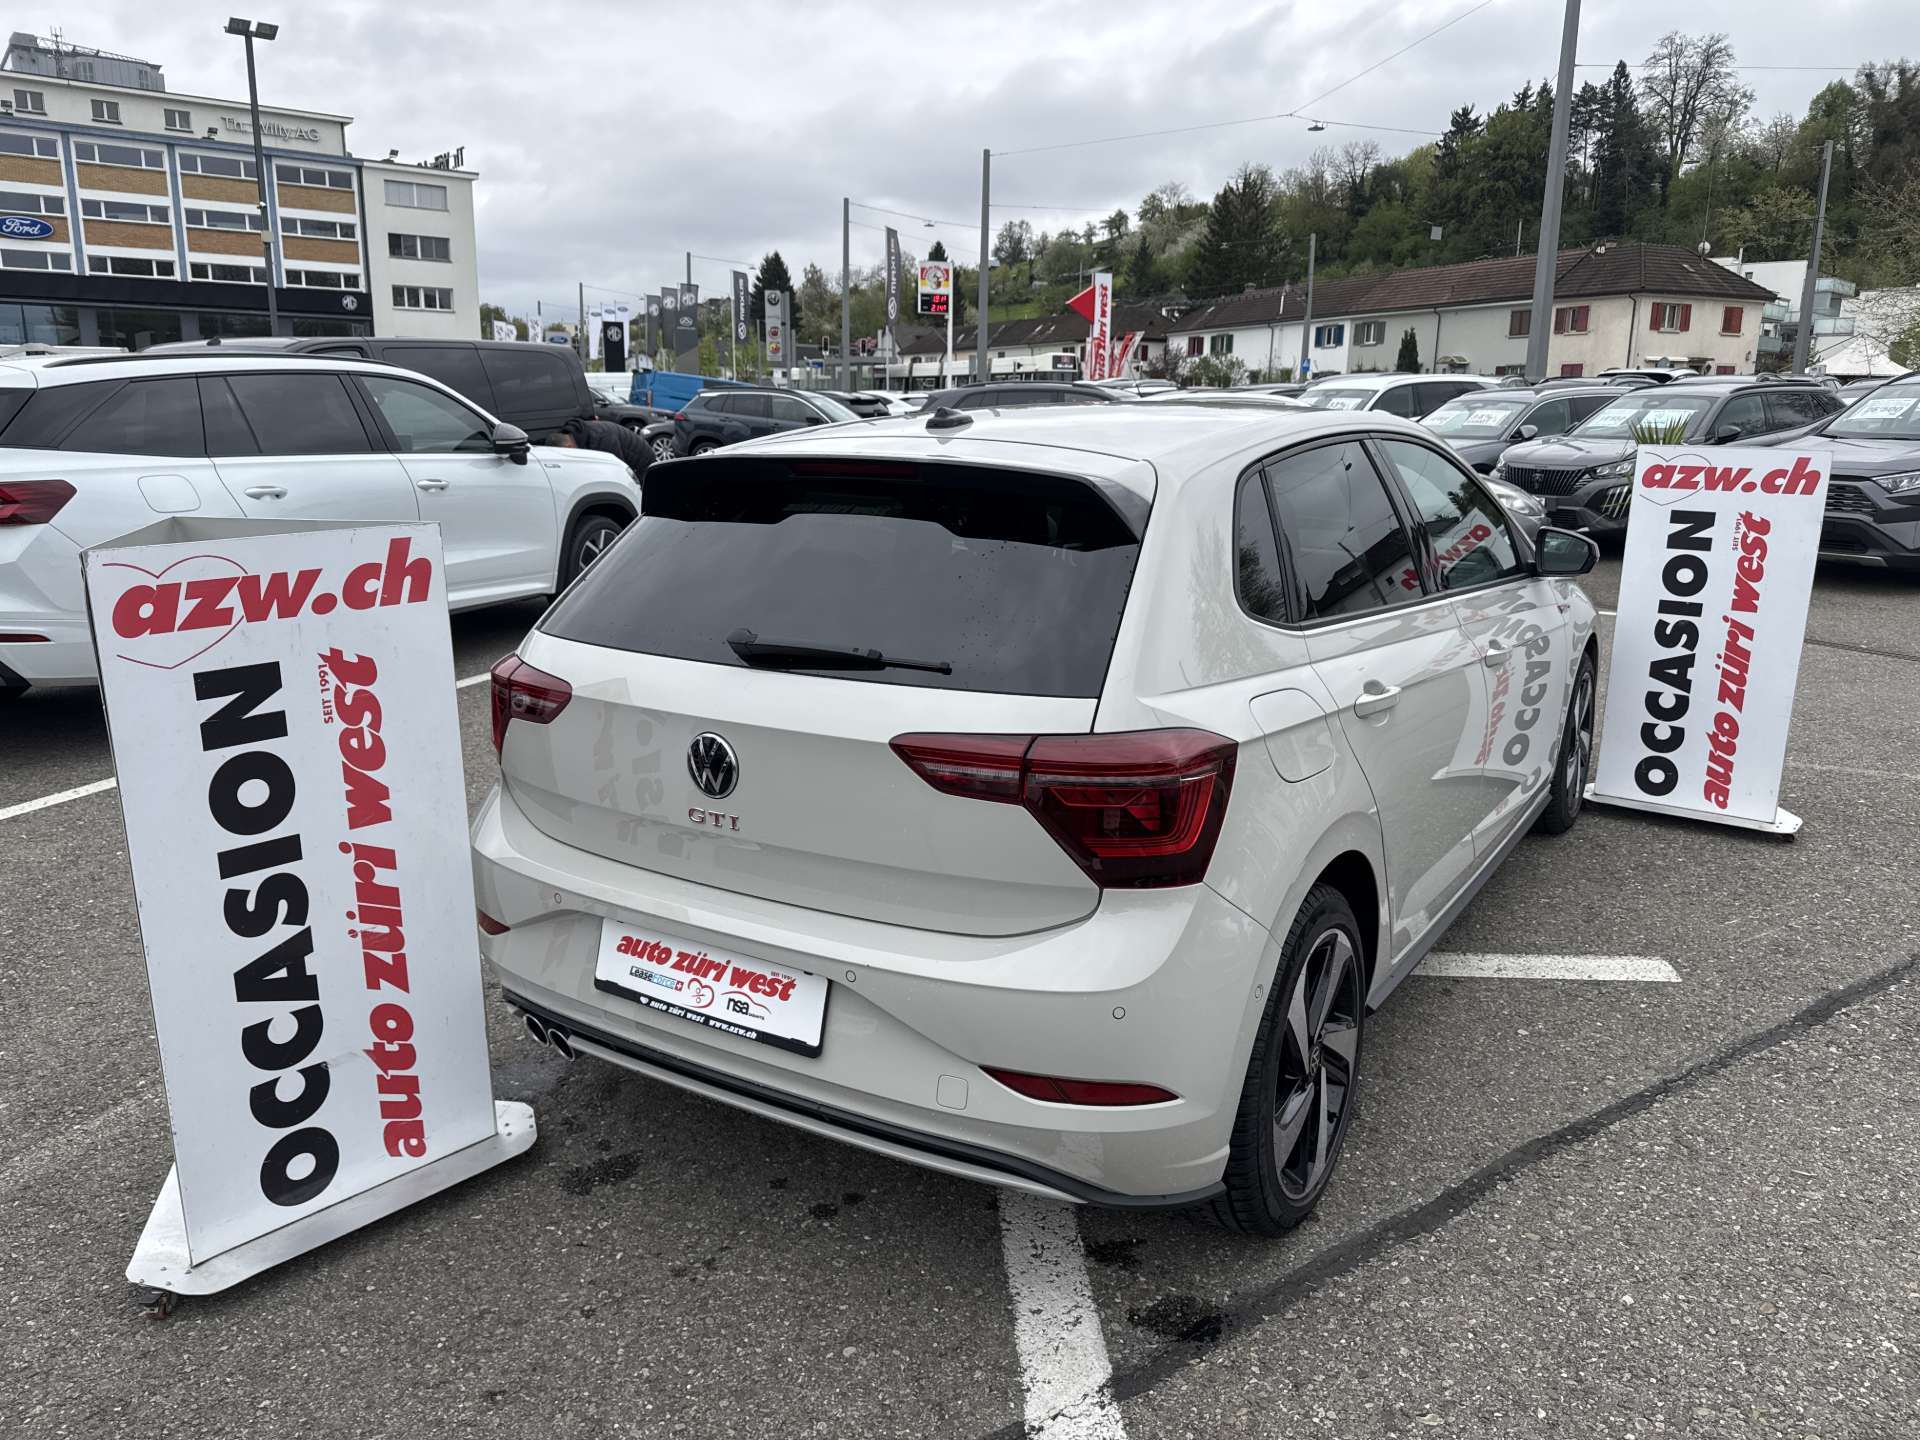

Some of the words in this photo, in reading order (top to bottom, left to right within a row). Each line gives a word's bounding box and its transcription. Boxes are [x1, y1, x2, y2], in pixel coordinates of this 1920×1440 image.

[295, 127, 321, 142] AG
[2, 218, 41, 235] Ford
[342, 294, 358, 310] MG
[606, 325, 622, 342] MG
[1642, 456, 1822, 496] azw.ch
[1731, 537, 1740, 551] SEIT
[1734, 518, 1743, 535] 1991
[1730, 510, 1772, 614] west
[111, 536, 433, 639] azw.ch
[1634, 509, 1717, 797] OCCASION
[1714, 614, 1755, 714] züri
[318, 663, 330, 695] 1991
[322, 699, 334, 725] SEIT
[317, 646, 393, 831] west
[1703, 711, 1740, 810] auto
[688, 807, 740, 832] GTI
[192, 660, 340, 1207] OCCASION
[338, 840, 411, 994] züri
[616, 935, 673, 966] auto
[669, 951, 732, 983] züri
[729, 966, 797, 1002] west
[649, 1000, 668, 1011] auto
[667, 1006, 686, 1017] züri
[685, 1012, 706, 1024] west
[708, 1019, 758, 1040] www.azw.ch
[726, 997, 750, 1016] nsa
[362, 1002, 427, 1158] auto
